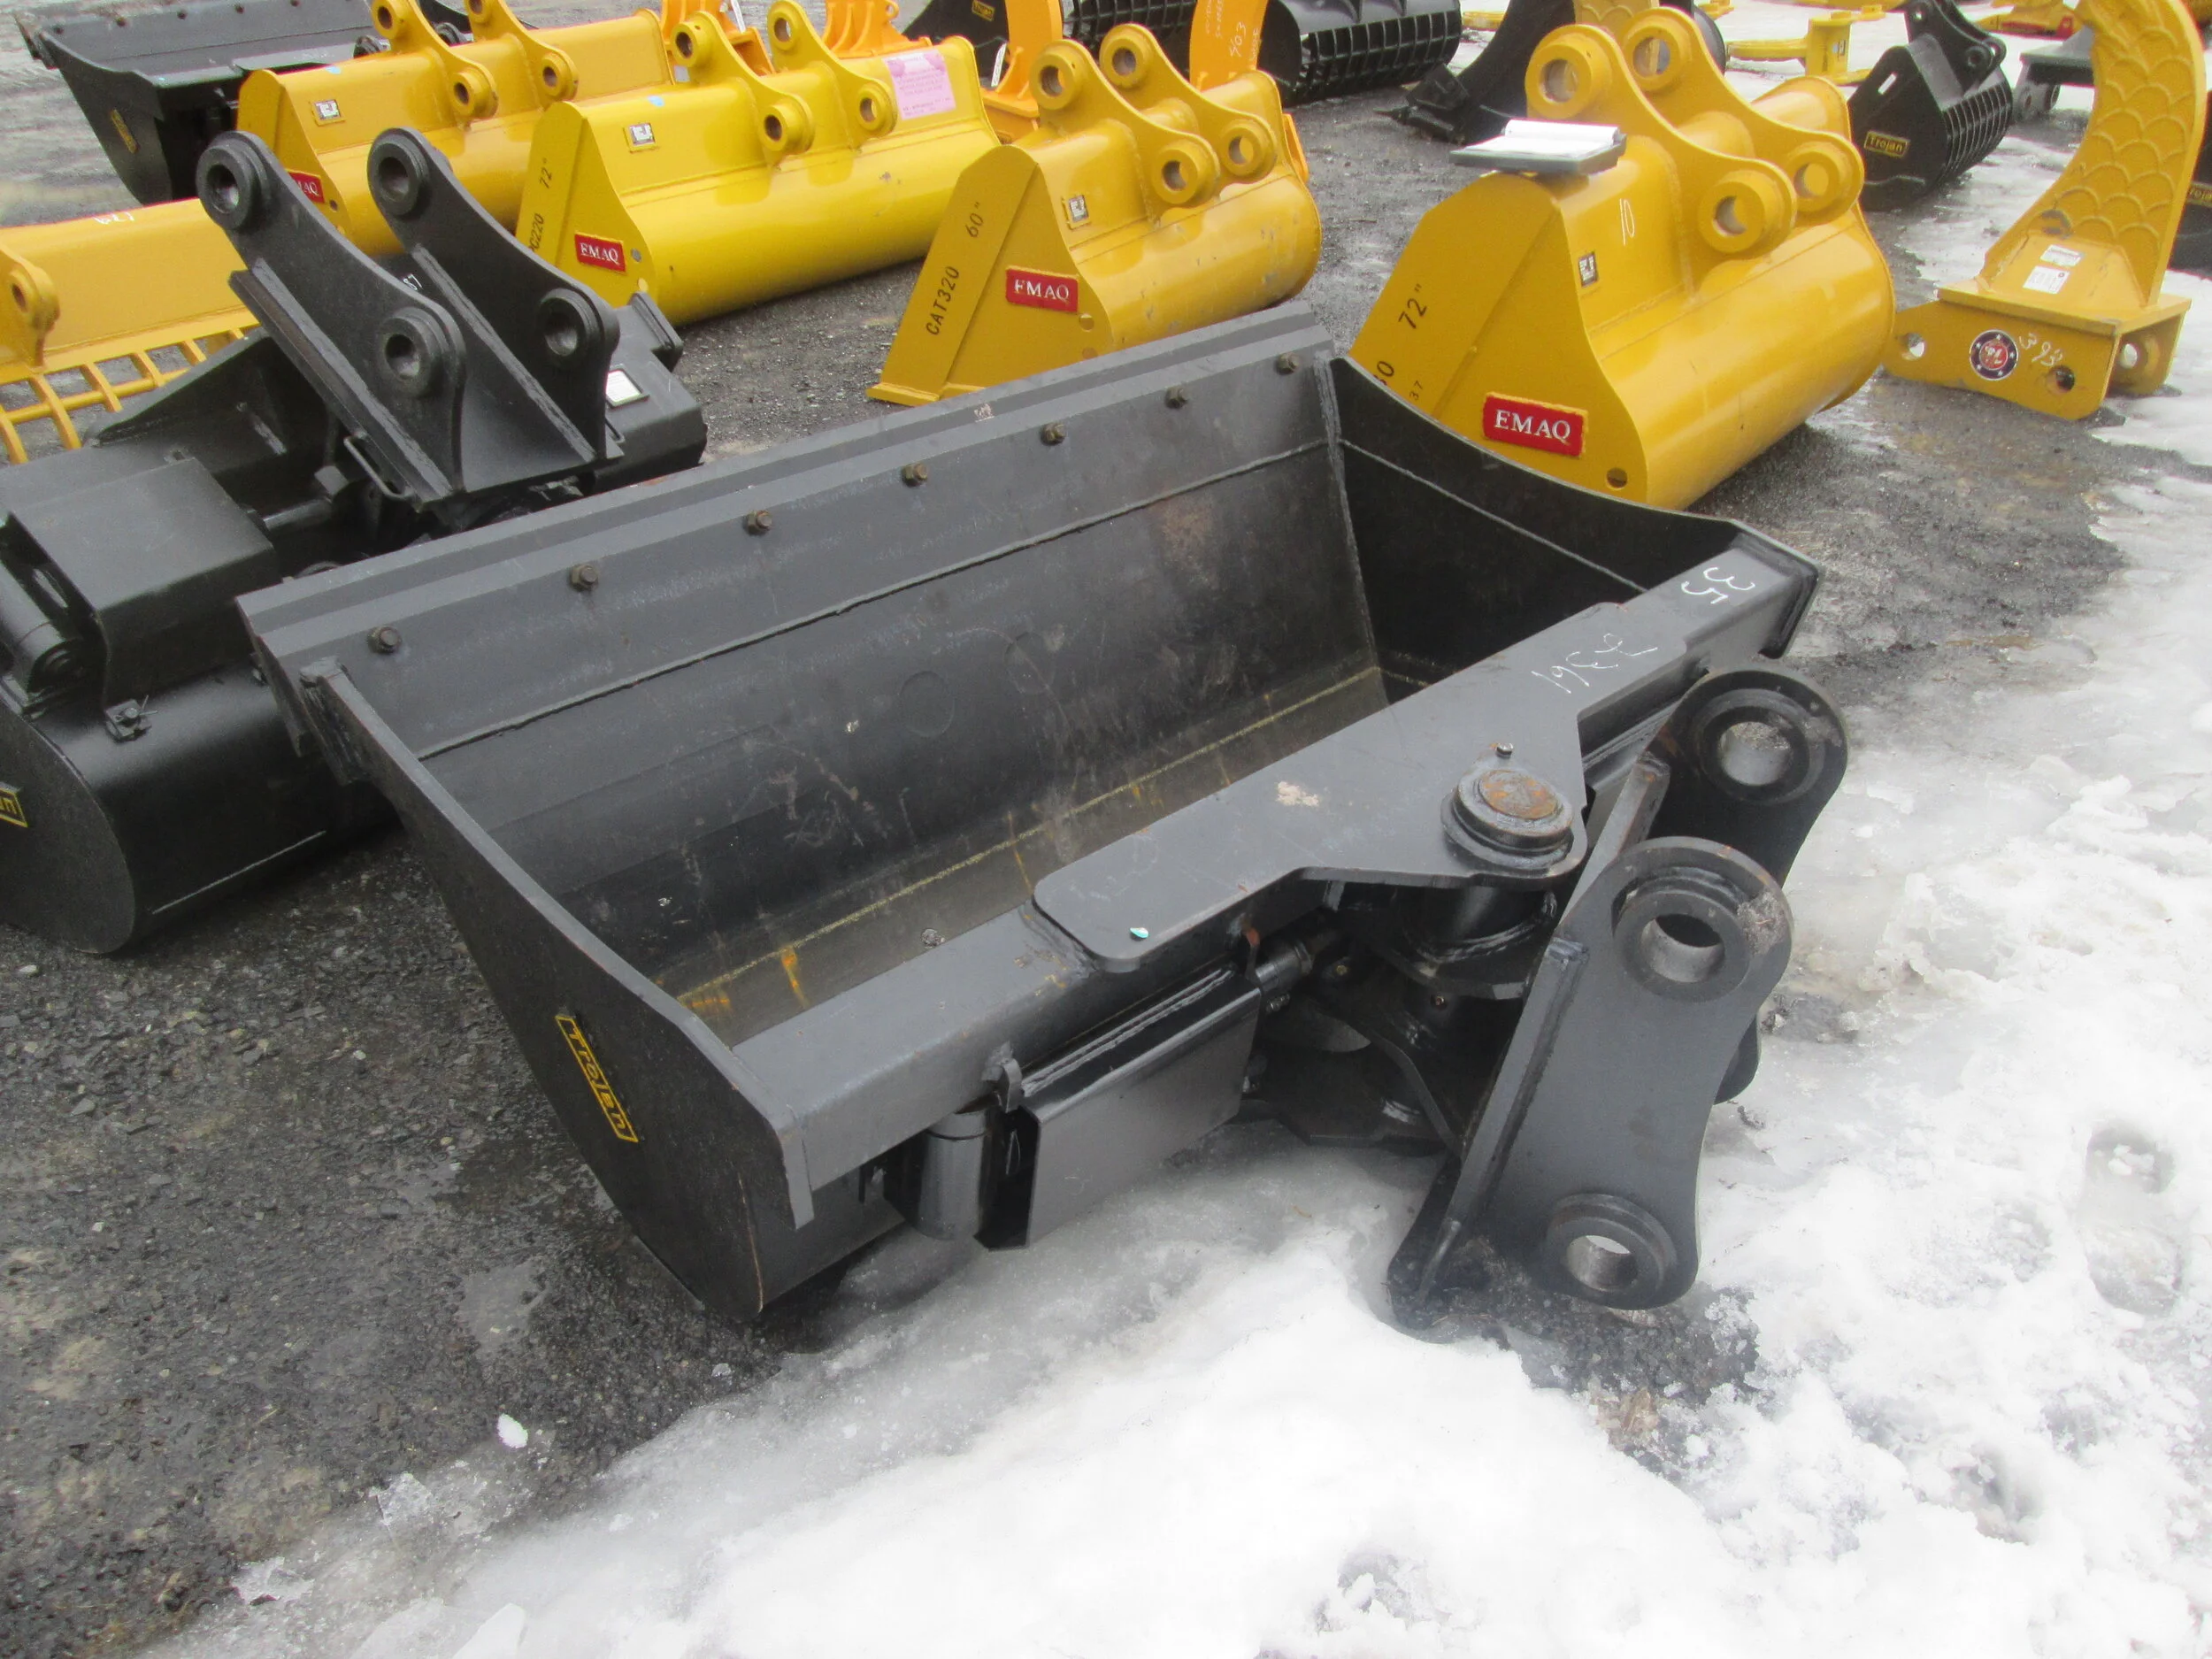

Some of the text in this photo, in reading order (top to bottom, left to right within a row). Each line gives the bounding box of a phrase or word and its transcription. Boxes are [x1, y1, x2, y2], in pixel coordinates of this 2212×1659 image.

[528, 212, 544, 252] C220
[1619, 198, 1635, 246] 10
[580, 242, 621, 265] EMAQ
[926, 202, 984, 335] CAT320 60"
[1398, 283, 1428, 329] 72"
[1494, 409, 1571, 446] EMAQ
[1681, 566, 1755, 604] 35
[567, 1026, 627, 1131] Trojan
